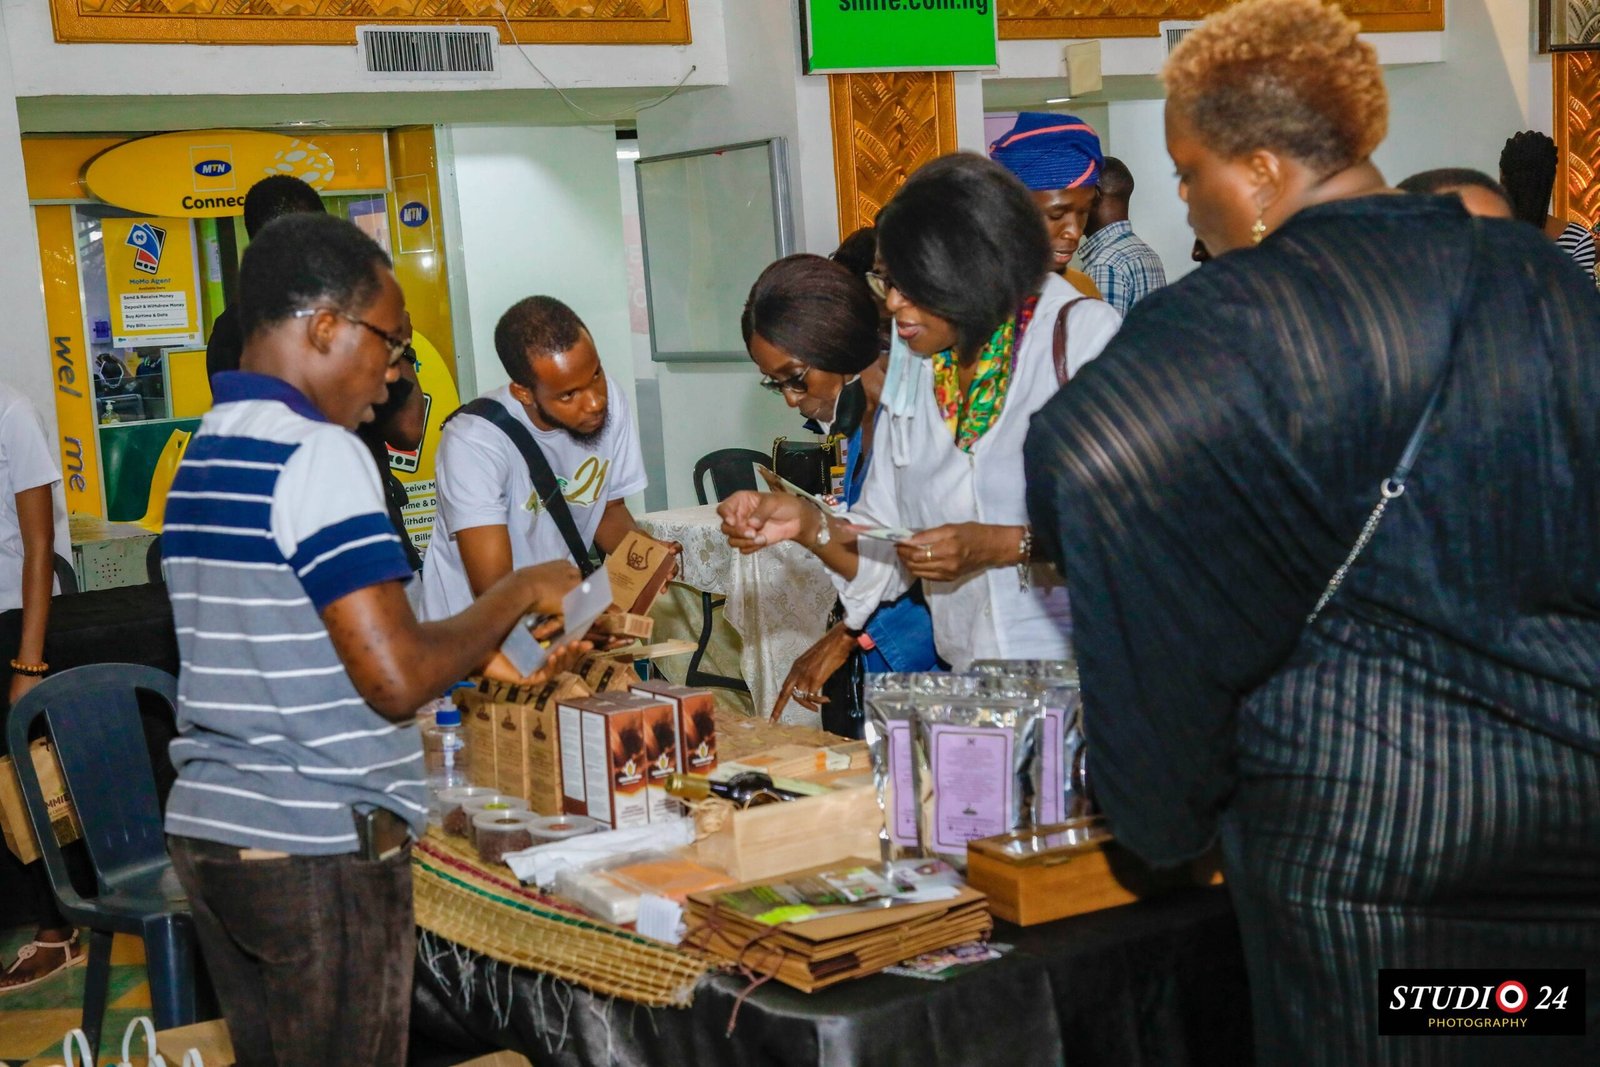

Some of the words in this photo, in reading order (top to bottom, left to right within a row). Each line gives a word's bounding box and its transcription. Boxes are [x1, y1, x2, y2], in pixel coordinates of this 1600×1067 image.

[202, 164, 225, 174] MTN
[182, 195, 246, 210] Connec
[404, 207, 422, 222] MTN
[54, 337, 83, 398] wel
[64, 436, 87, 493] me
[564, 456, 609, 503] 21
[405, 484, 427, 493] ceive
[422, 499, 428, 507] &
